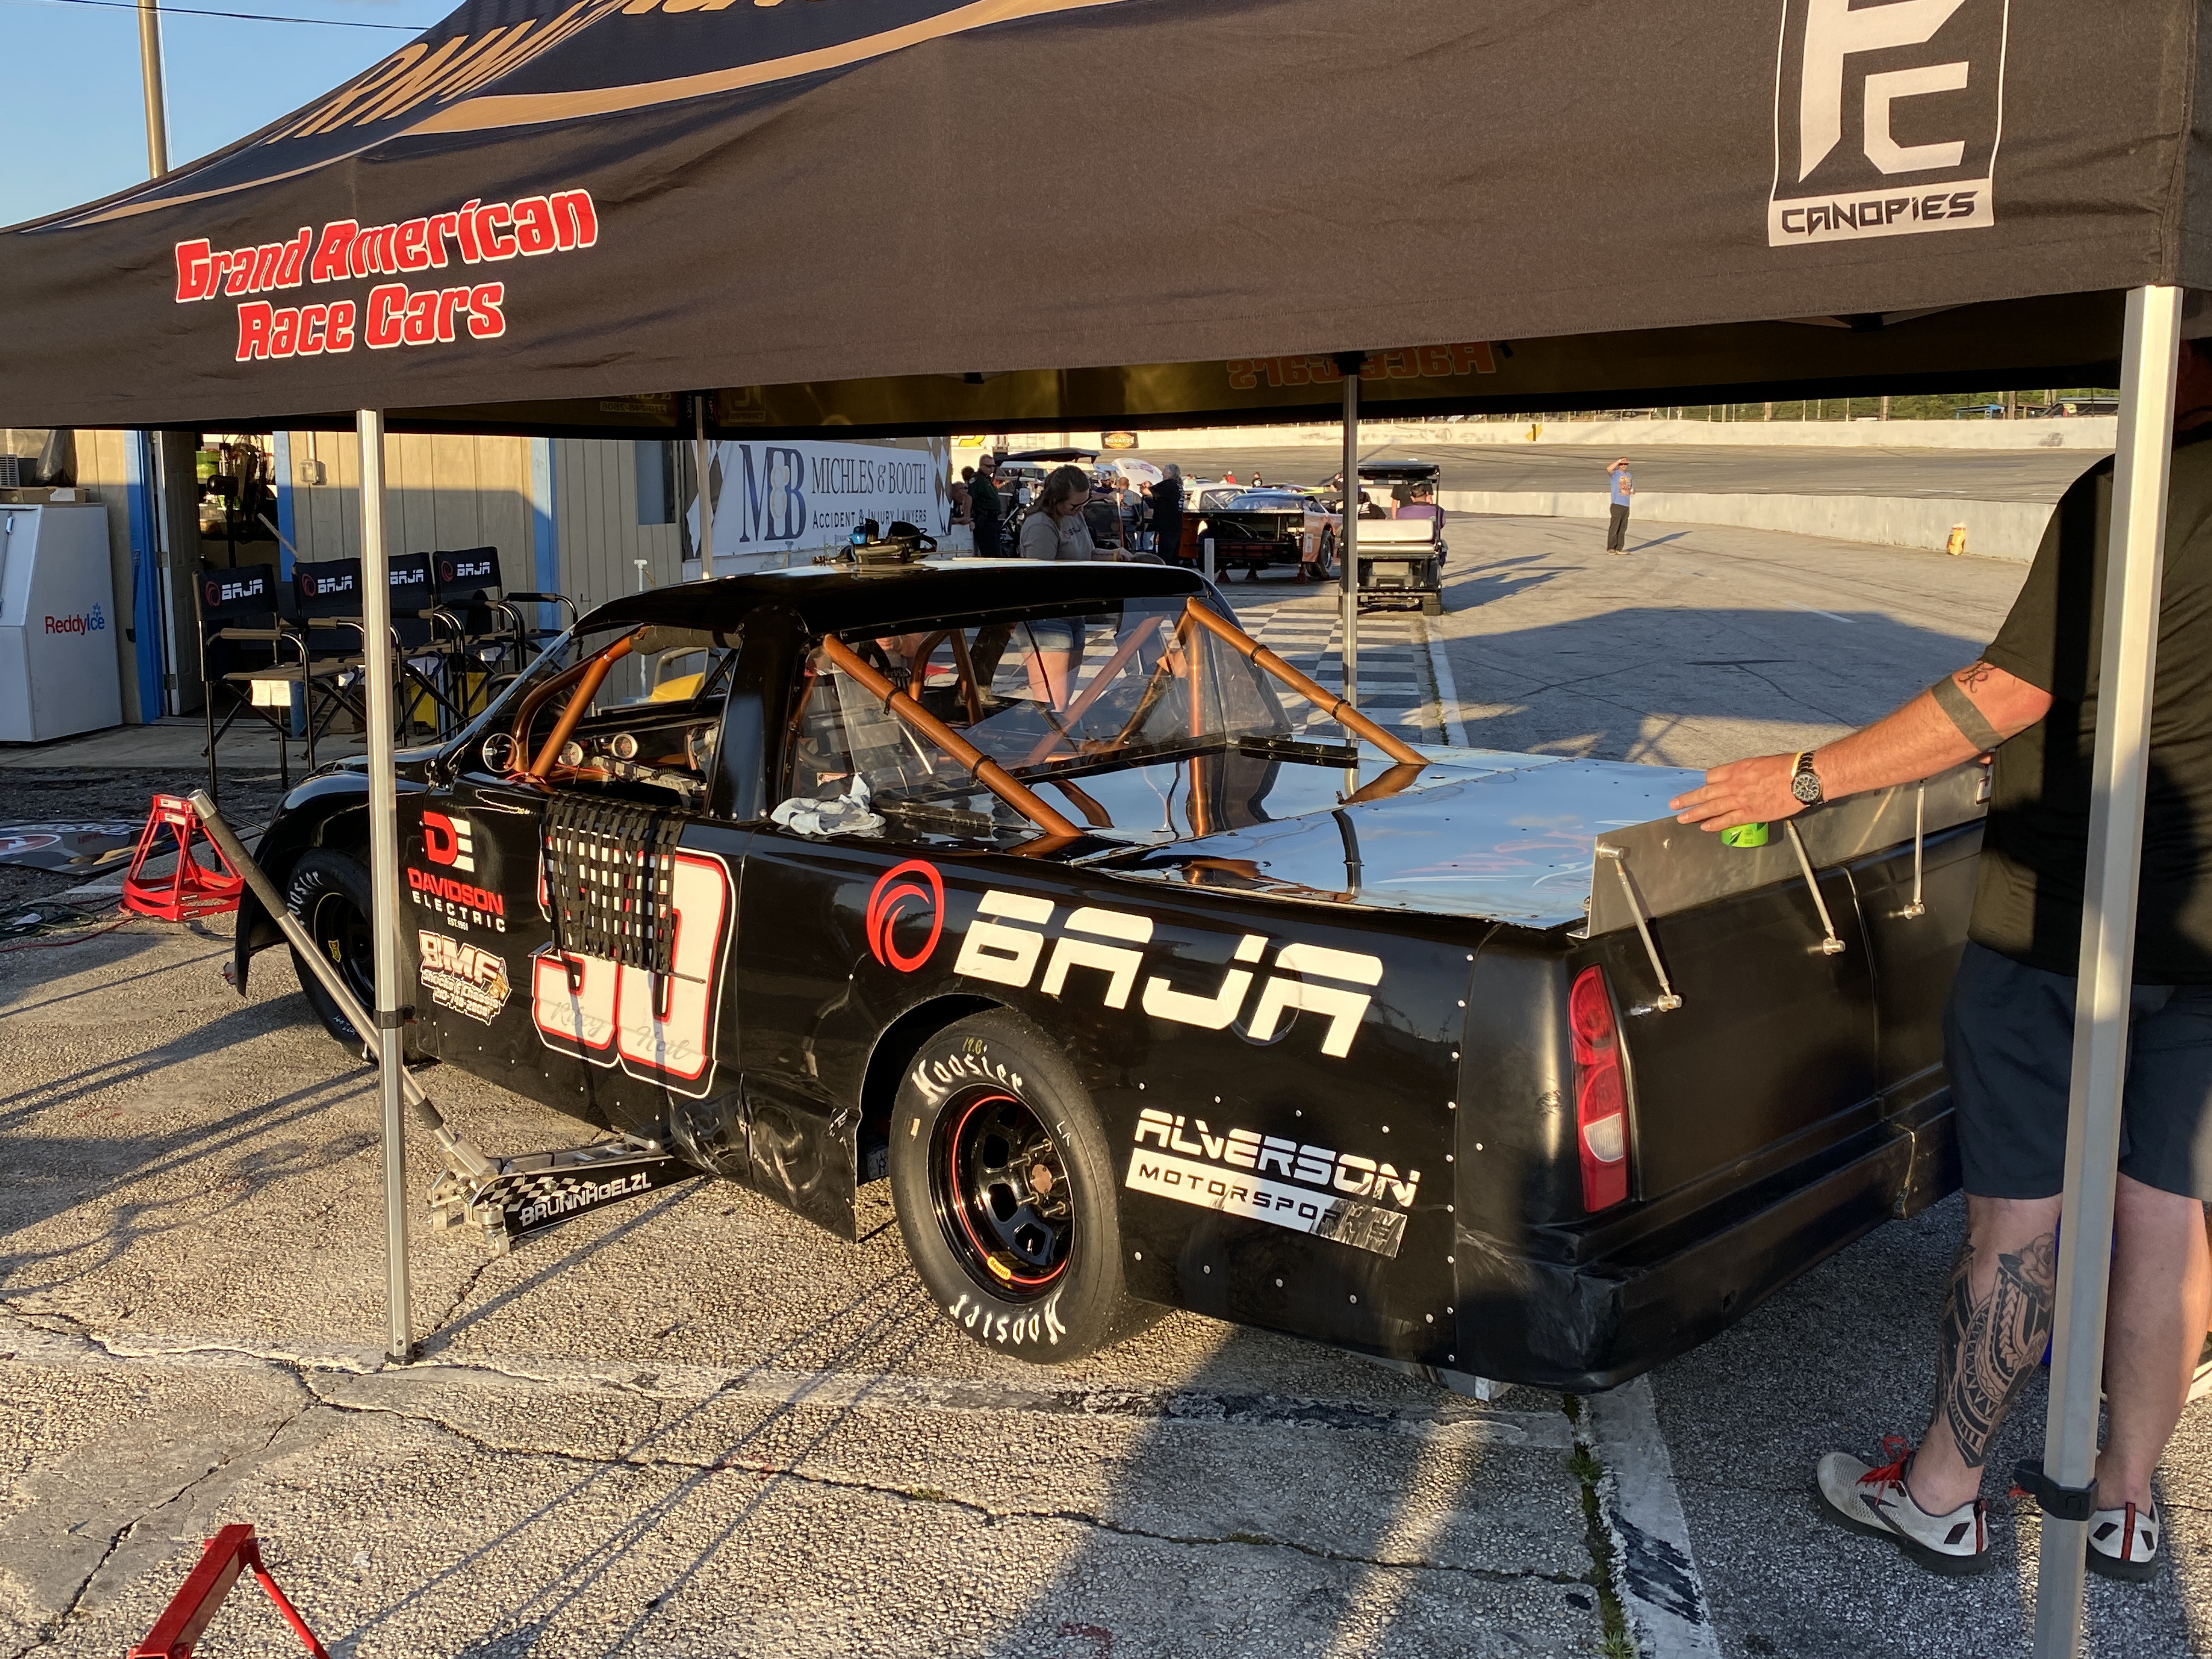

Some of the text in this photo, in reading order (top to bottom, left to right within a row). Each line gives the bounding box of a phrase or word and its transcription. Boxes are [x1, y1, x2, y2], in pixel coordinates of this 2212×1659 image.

[175, 189, 599, 303] Grand American
[235, 281, 507, 362] Race Cars
[811, 456, 874, 494] MICHLES
[888, 461, 927, 494] BOOTH
[222, 579, 263, 600] BAJA
[318, 575, 352, 593] BAJA
[390, 568, 424, 585] BAJA
[457, 561, 490, 577] BAJA
[407, 867, 504, 916] DAVIDSON
[412, 890, 506, 933] ELECTRIC
[419, 929, 502, 984] BMF
[953, 889, 1384, 1058] BAJA
[1134, 1108, 1421, 1207] ALVERSON
[518, 1171, 652, 1227] BRUNNHOELZL
